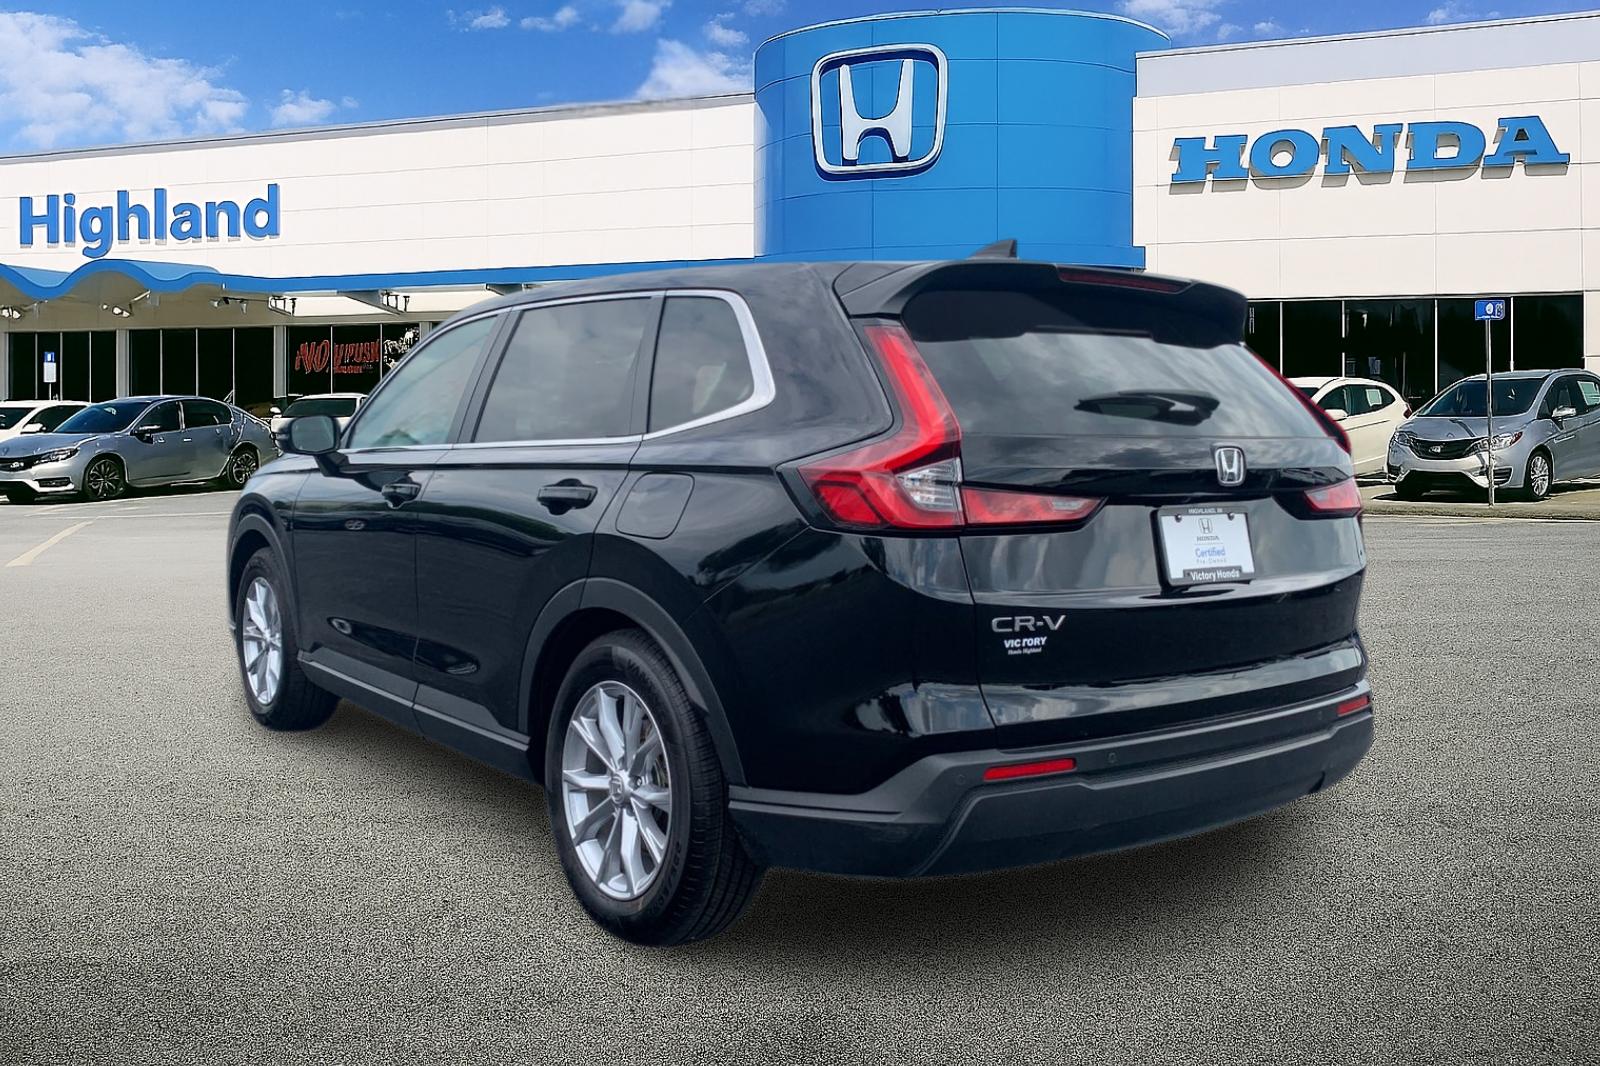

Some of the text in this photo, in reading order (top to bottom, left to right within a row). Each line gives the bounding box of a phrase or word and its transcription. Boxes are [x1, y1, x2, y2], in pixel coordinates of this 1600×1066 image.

[1170, 115, 1571, 186] HONDA
[19, 183, 281, 259] Highland
[1195, 546, 1226, 558] Certified
[1190, 568, 1240, 582] Victory Honda
[991, 614, 1067, 633] CR-V
[1003, 636, 1048, 649] VICTORY
